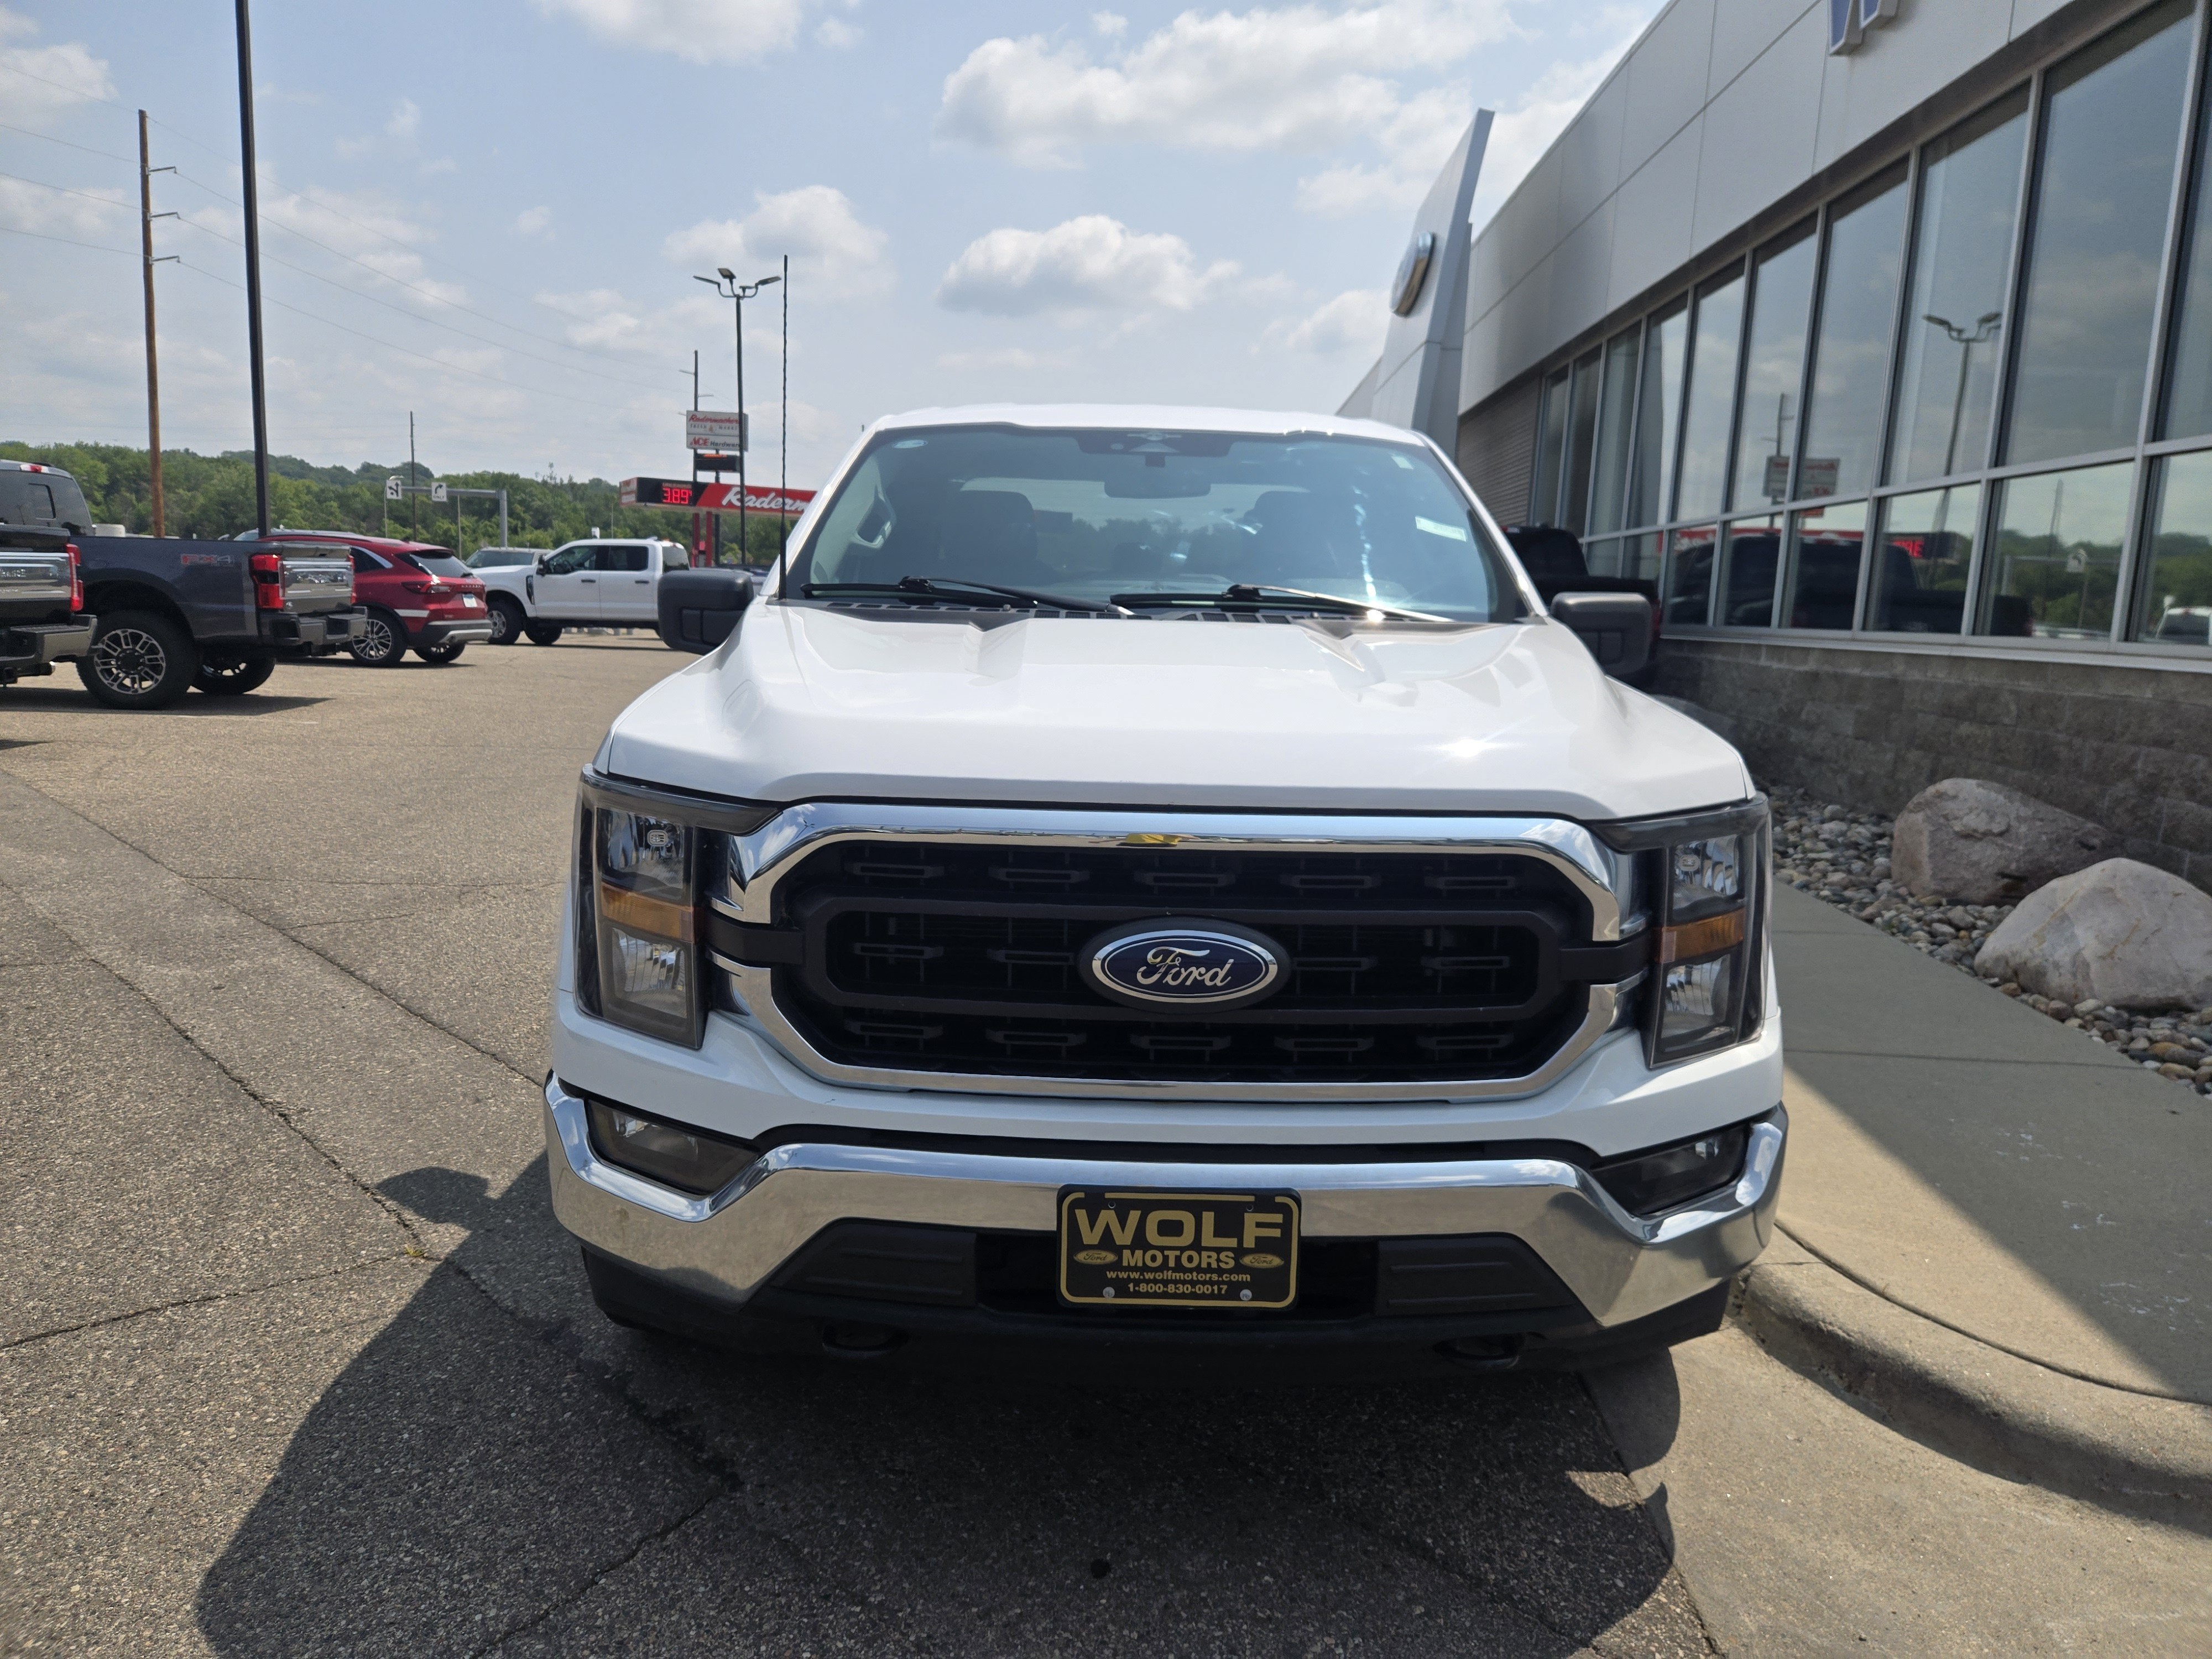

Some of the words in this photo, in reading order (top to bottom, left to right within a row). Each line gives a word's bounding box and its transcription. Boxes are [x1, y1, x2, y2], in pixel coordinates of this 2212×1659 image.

[1136, 946, 1234, 987] Ford
[1074, 1209, 1284, 1248] WOLF
[1122, 1249, 1235, 1269] MOTORS
[1106, 1270, 1251, 1282] www.wolfmotors.com
[1128, 1282, 1228, 1295] 1-800-830-0017
